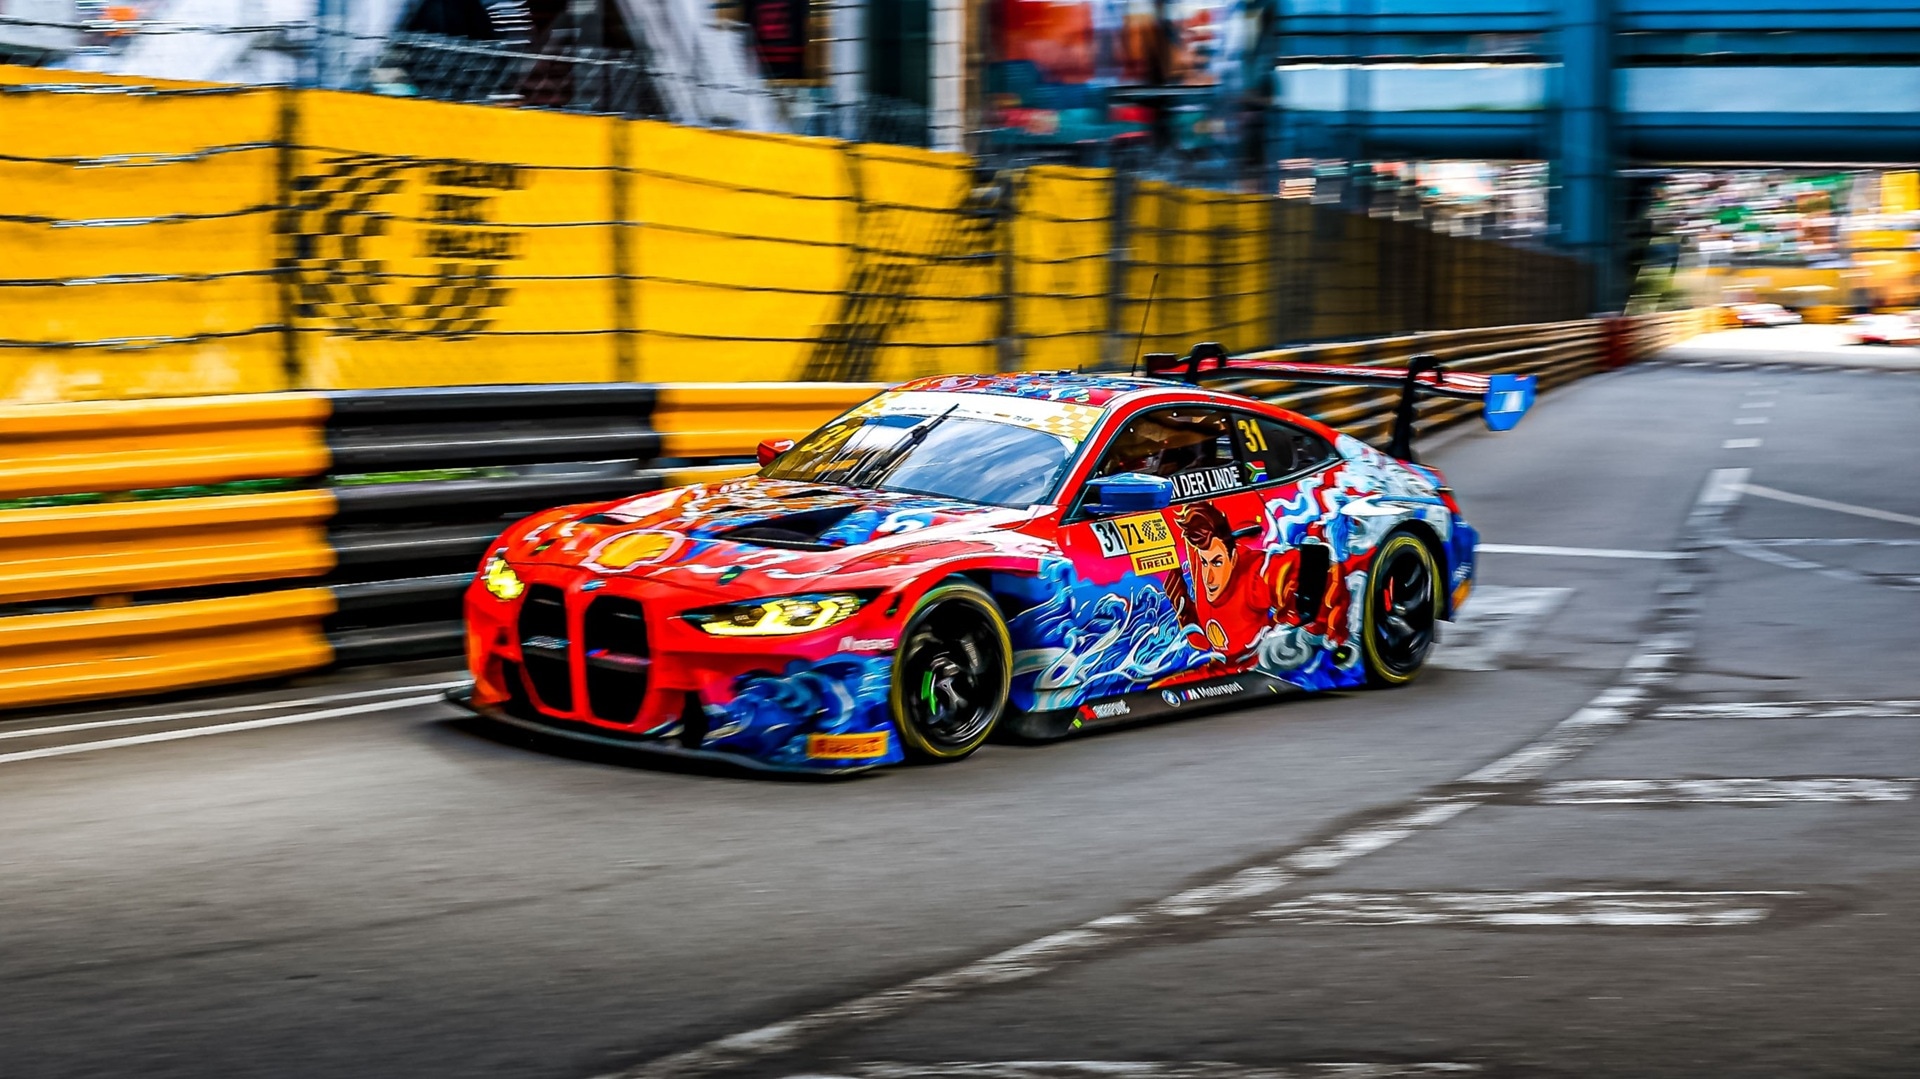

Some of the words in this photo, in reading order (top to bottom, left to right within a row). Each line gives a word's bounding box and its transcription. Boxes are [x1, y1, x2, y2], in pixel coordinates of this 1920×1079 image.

[799, 424, 861, 452] 31
[1237, 418, 1268, 452] 31
[1179, 472, 1208, 497] DER
[1205, 466, 1243, 492] LINDE
[1095, 521, 1124, 553] 31
[1120, 523, 1145, 546] 71
[1135, 551, 1175, 571] PIRELLI
[1197, 681, 1244, 698] Motorsport
